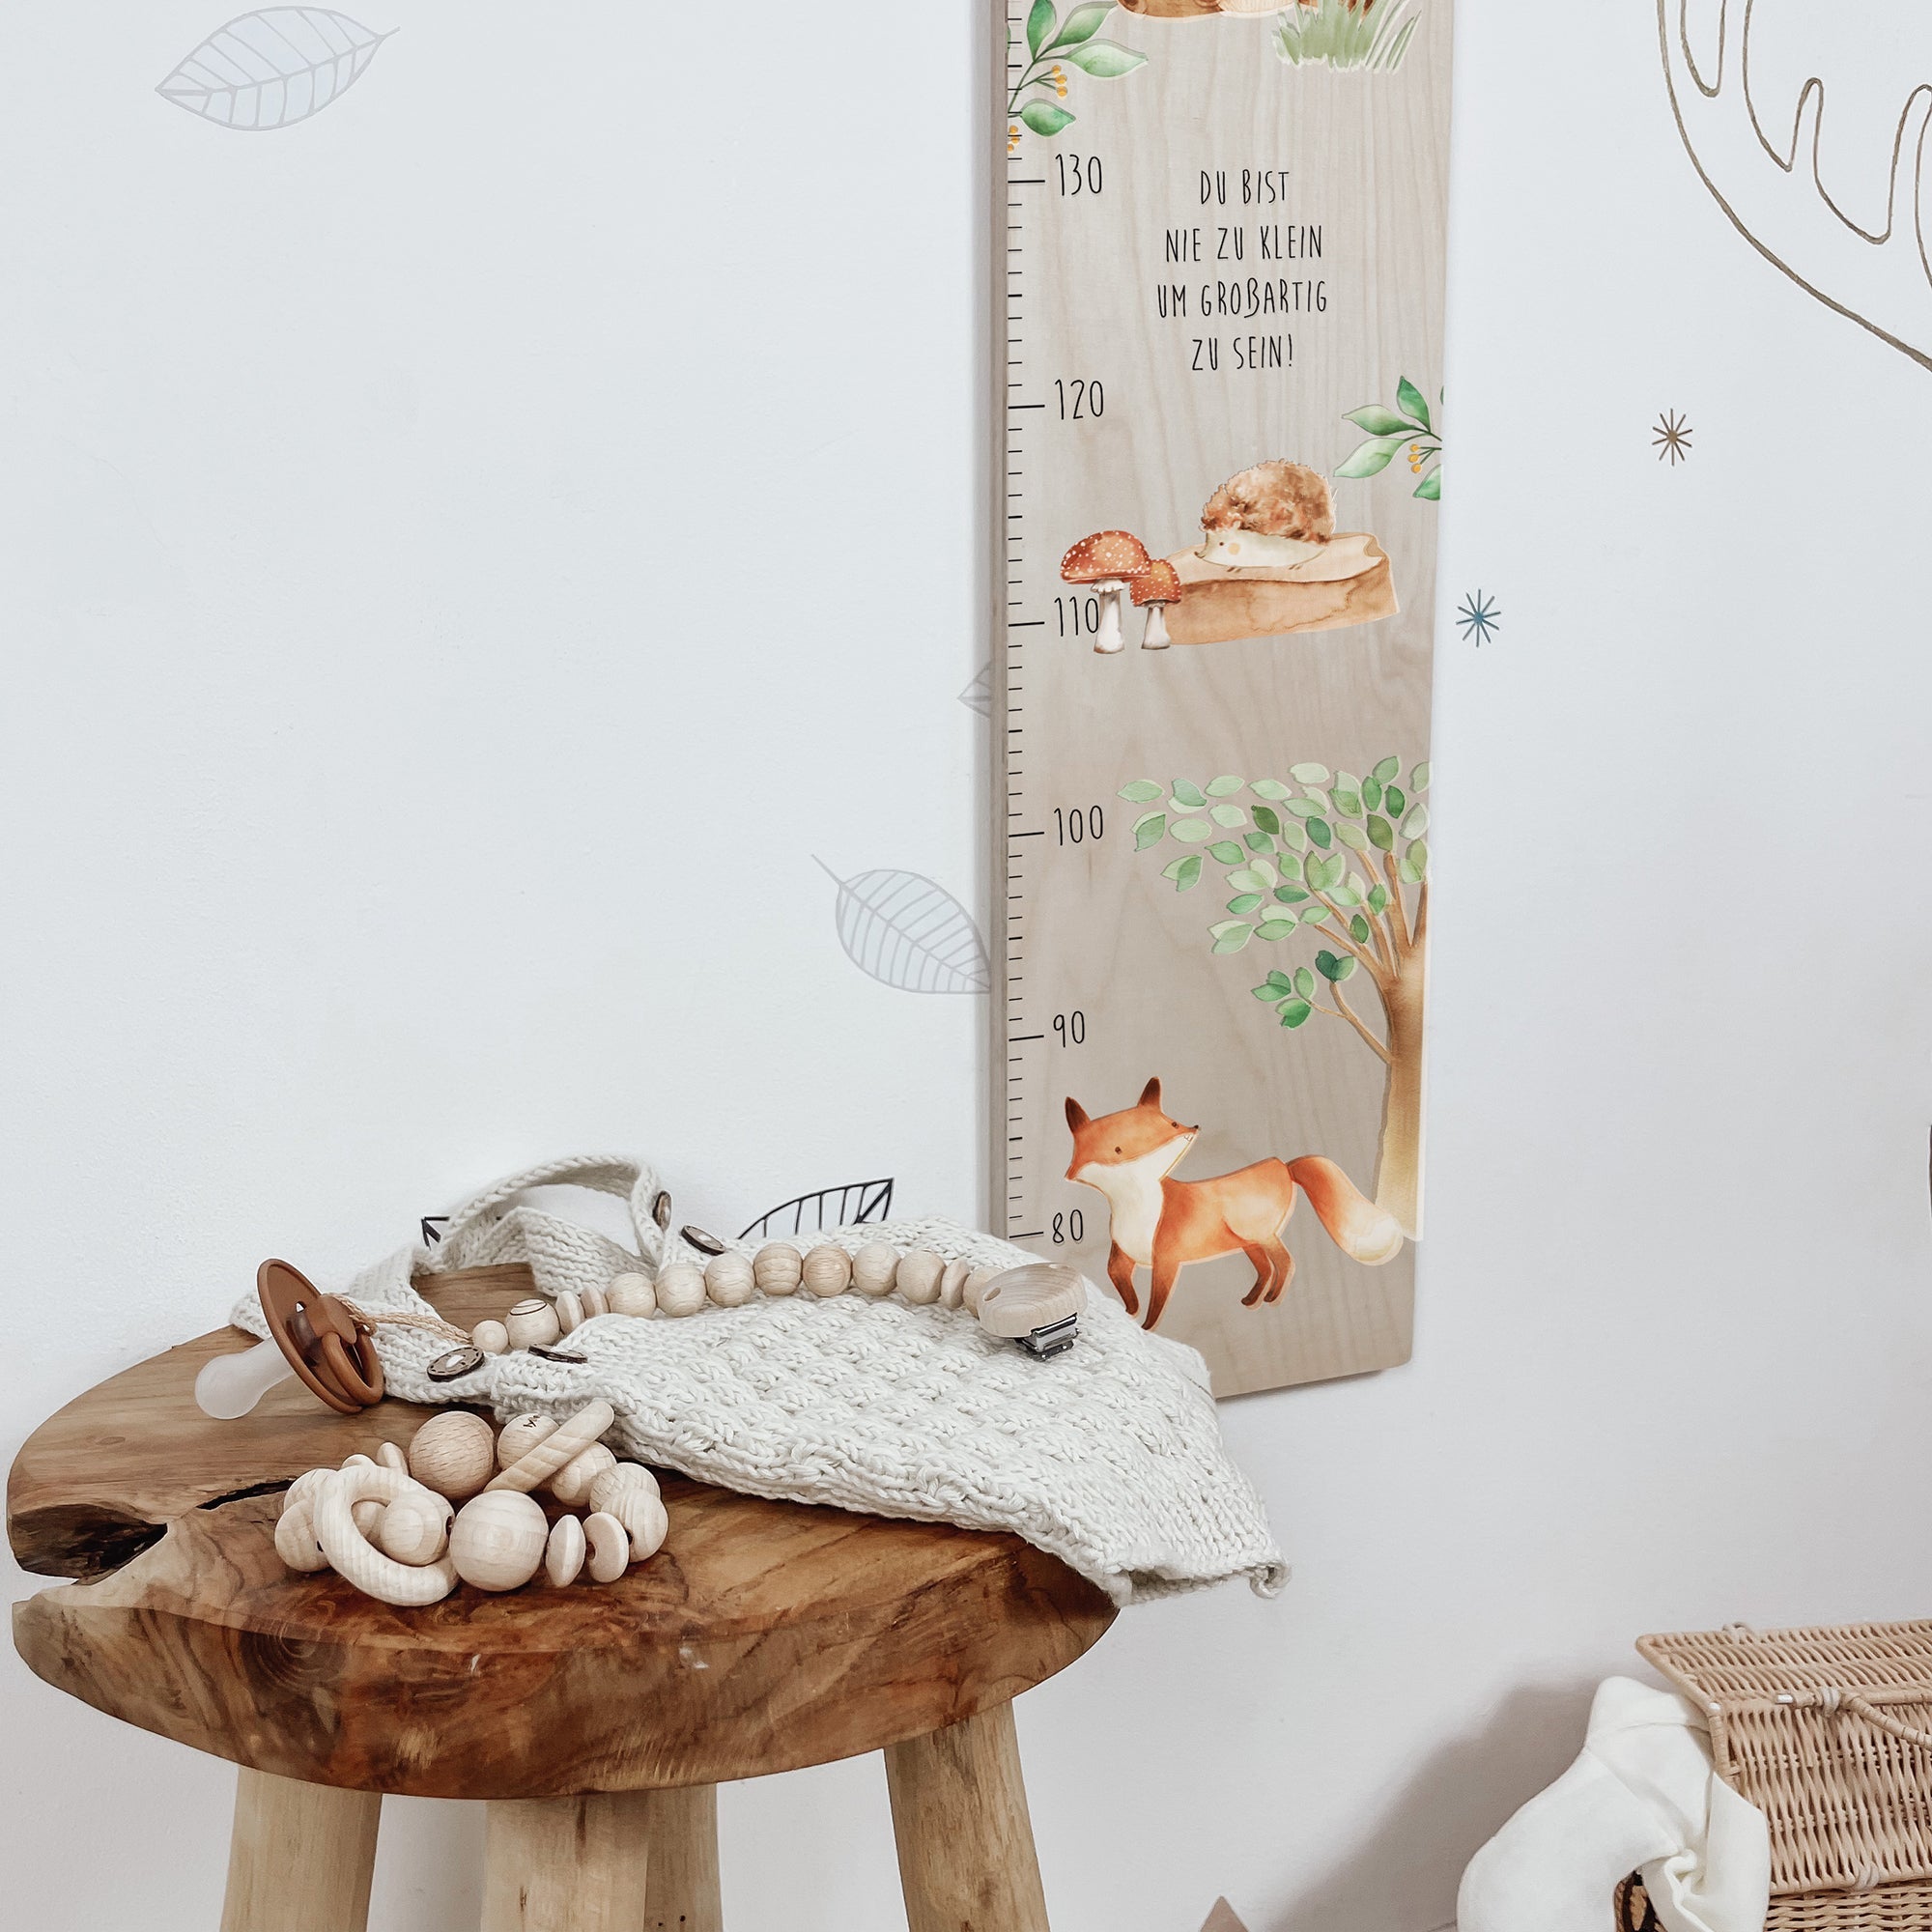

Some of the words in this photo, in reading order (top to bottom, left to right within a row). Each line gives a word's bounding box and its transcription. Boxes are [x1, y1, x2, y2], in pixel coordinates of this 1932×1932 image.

[1054, 153, 1103, 197] 130
[1200, 169, 1226, 206] DU
[1241, 168, 1291, 205] BIST
[1165, 227, 1202, 264] NIE
[1216, 226, 1244, 261] ZU
[1260, 224, 1322, 260] KLEIN
[1157, 284, 1186, 319] UM
[1191, 336, 1218, 372] ZU
[1233, 332, 1293, 370] SEIN!
[1054, 378, 1104, 421] 120
[1054, 596, 1099, 637] 110
[1053, 805, 1104, 847] 100
[1052, 1010, 1086, 1049] 90
[1052, 1208, 1084, 1244] 80
